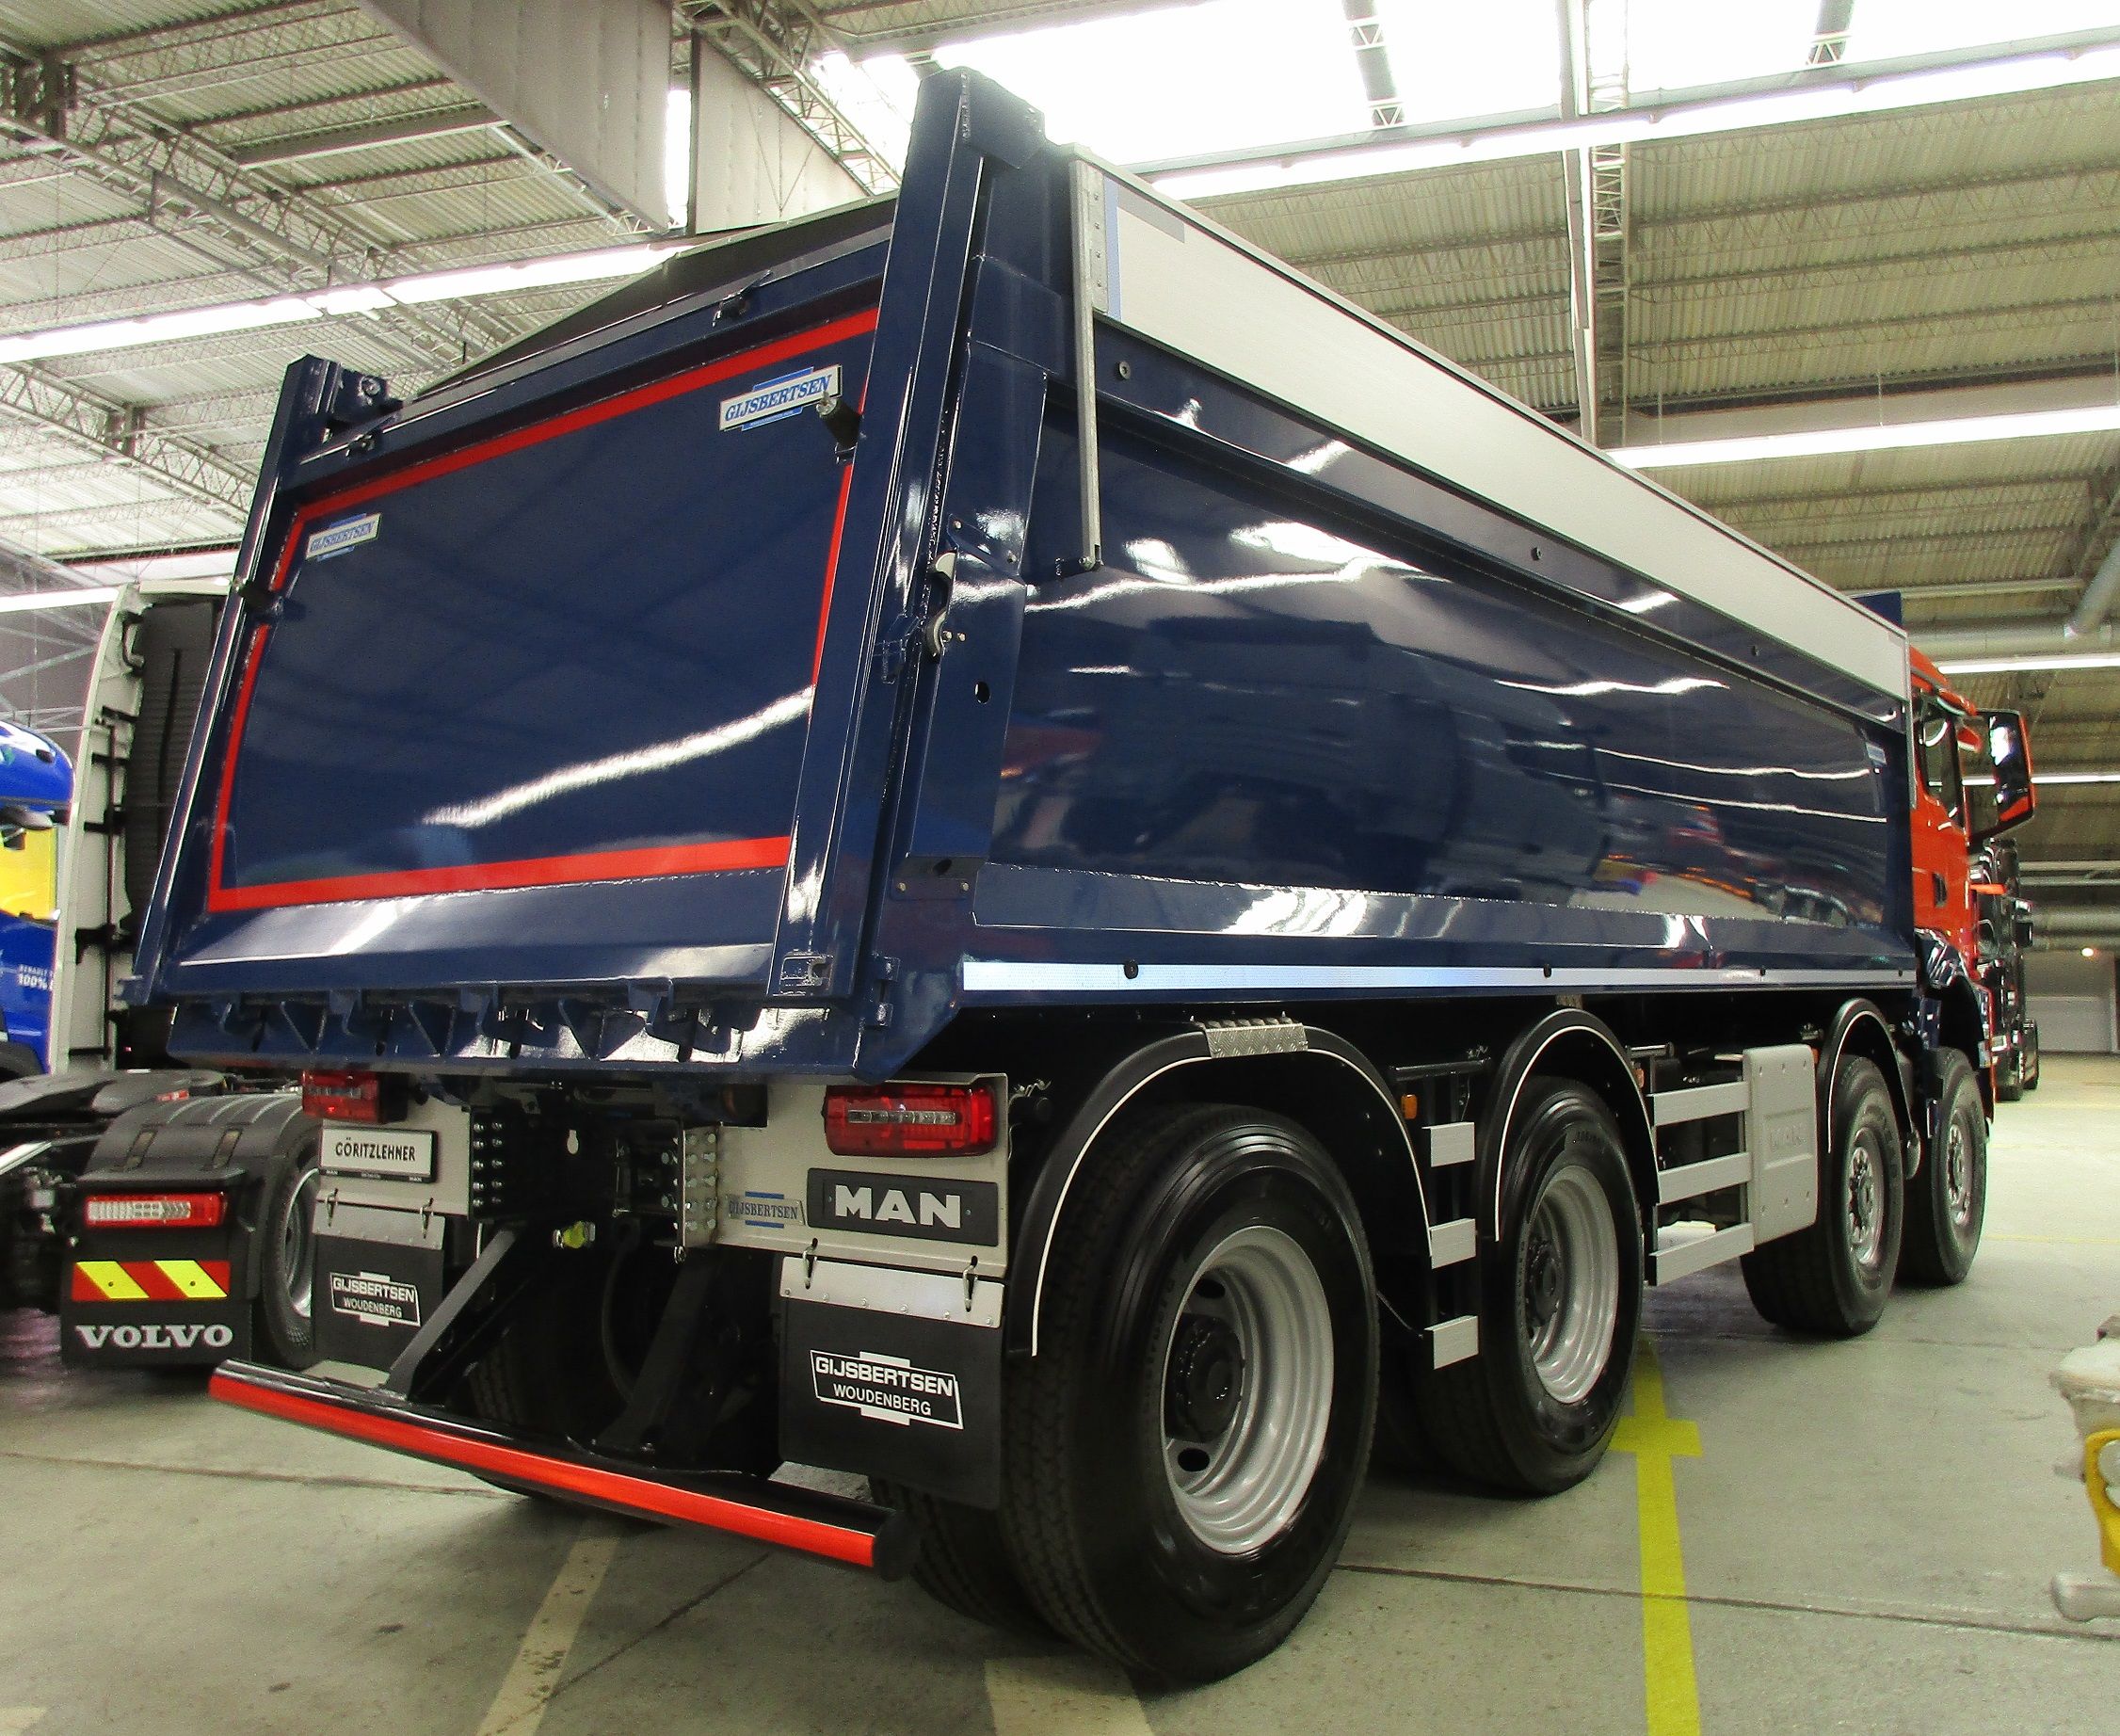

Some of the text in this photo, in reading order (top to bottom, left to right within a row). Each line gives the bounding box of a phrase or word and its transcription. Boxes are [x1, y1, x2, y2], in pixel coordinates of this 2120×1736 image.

[725, 374, 832, 422] GIJSBERTSEN
[335, 1136, 416, 1162] GÖRITZLEHNER
[835, 1184, 961, 1229] MAN
[332, 1277, 415, 1303] GIJSBERTSEN
[344, 1296, 402, 1319] WOUDENBERG
[74, 1324, 233, 1349] VOLVO
[815, 1356, 954, 1397] GIJSBERTSEN
[833, 1383, 932, 1416] WOUDENBERG
